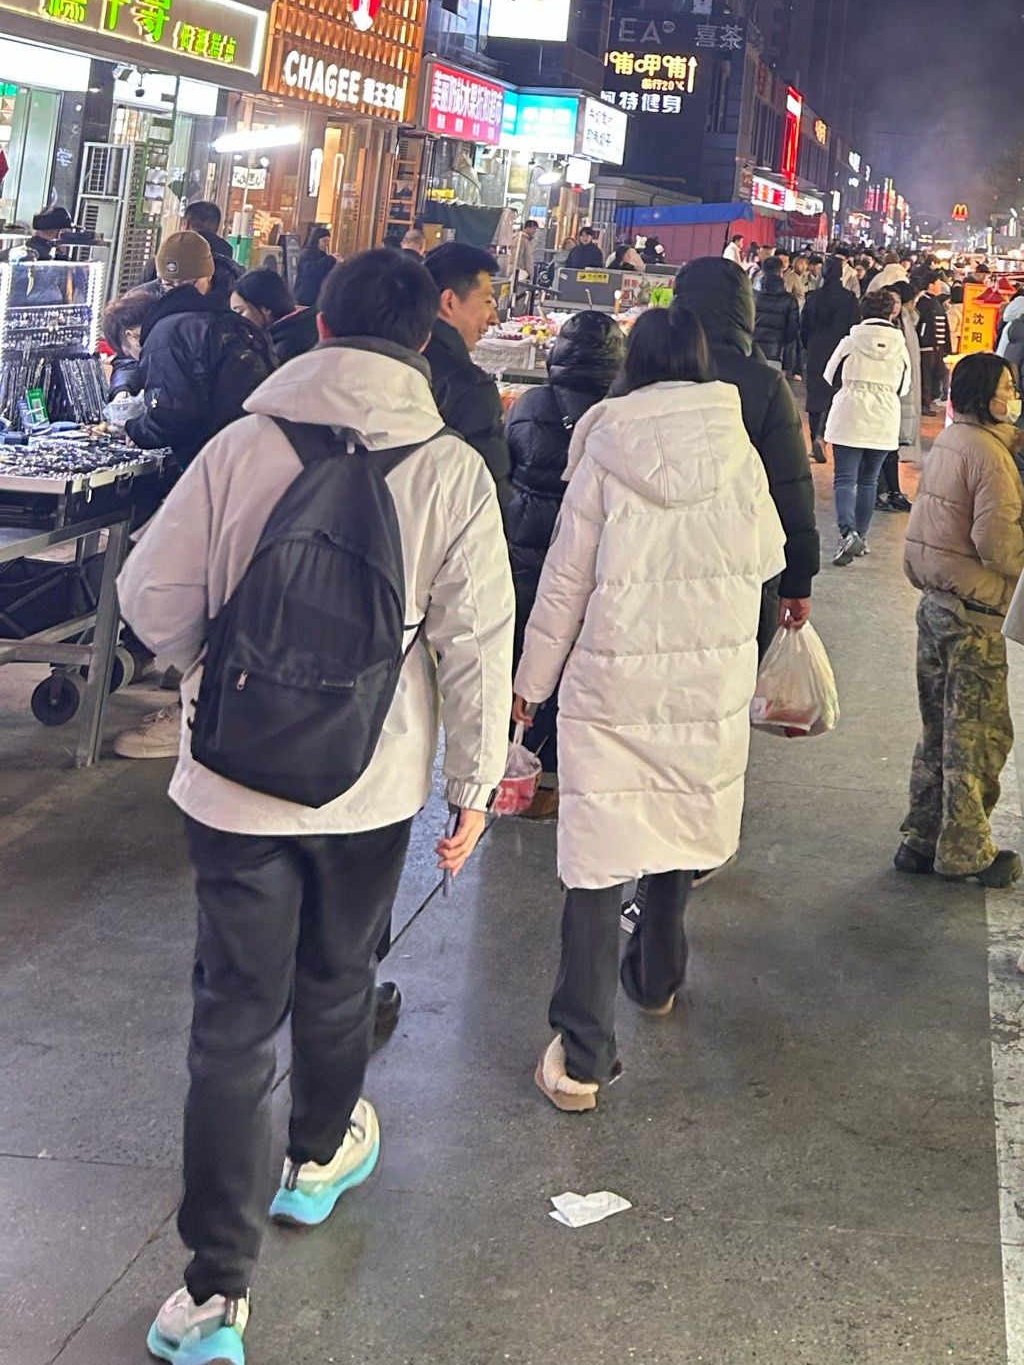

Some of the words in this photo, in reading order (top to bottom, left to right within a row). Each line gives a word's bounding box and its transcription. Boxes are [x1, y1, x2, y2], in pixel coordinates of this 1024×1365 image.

[694, 22, 744, 51] 喜茶
[284, 49, 362, 105] CHAGEE
[604, 50, 688, 80] 哺呷哺
